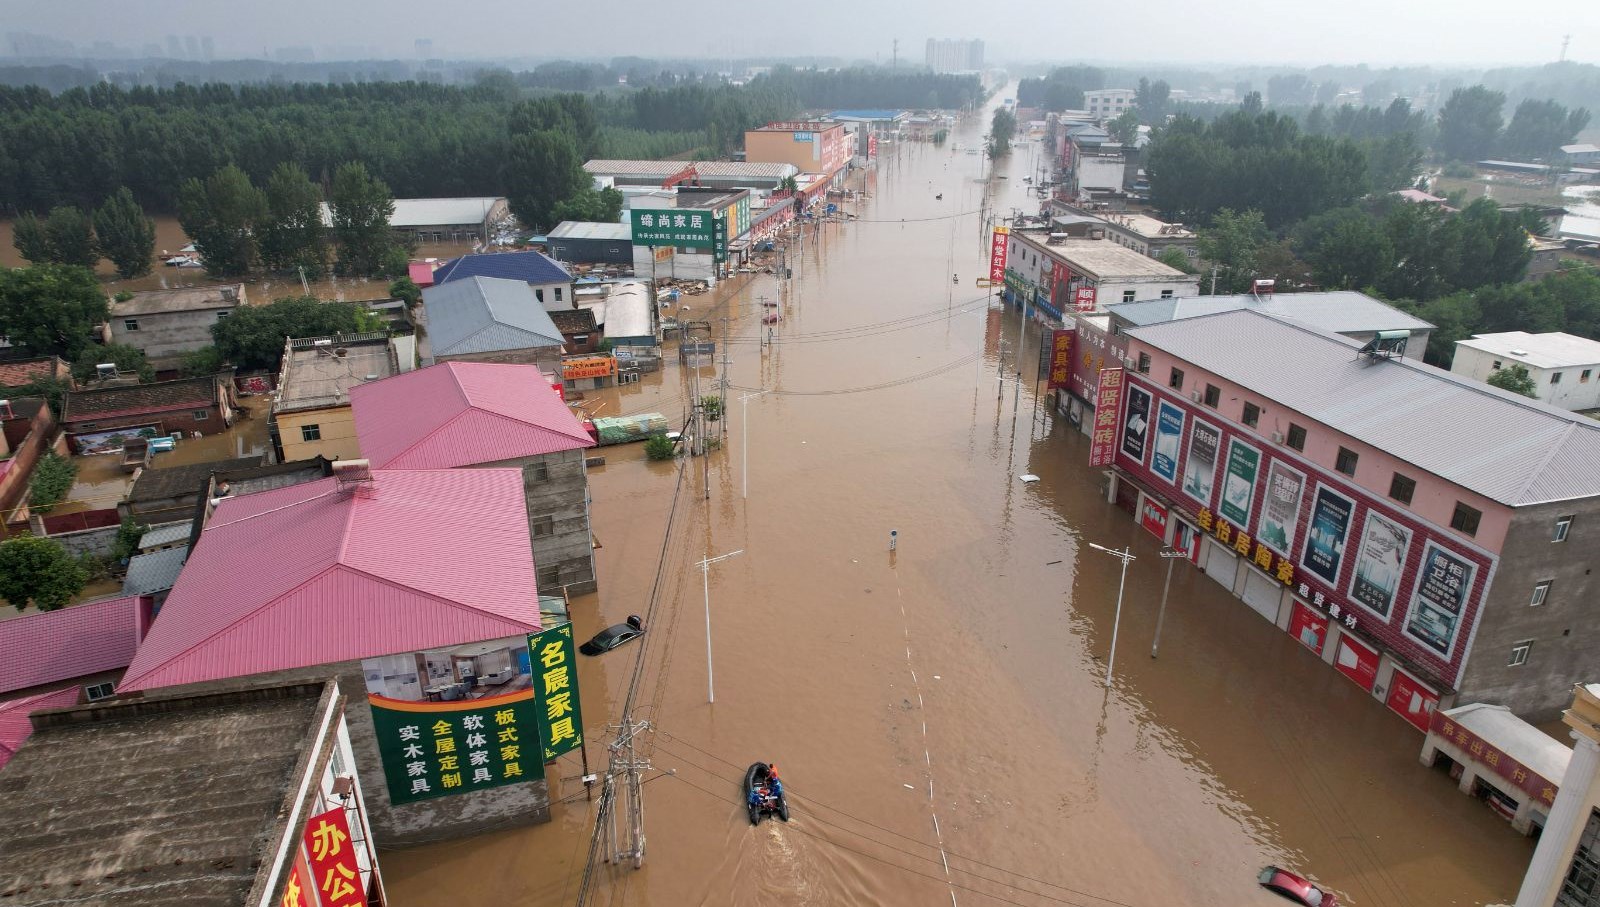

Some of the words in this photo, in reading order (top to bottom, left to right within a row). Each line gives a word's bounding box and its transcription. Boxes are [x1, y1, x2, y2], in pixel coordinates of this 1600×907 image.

[640, 213, 703, 229] 缔尚家居
[993, 234, 1006, 278] 明堂红木
[1052, 335, 1071, 382] 家具城
[1095, 370, 1121, 444] 超贤瓷砖
[1198, 506, 1295, 585] 佳怡居陶瓷
[1430, 566, 1460, 588] 卫浴
[1434, 554, 1463, 577] 橱柜
[1298, 582, 1358, 630] 超贤建材
[540, 639, 575, 747] 名宸家具
[398, 724, 431, 795] 实木家具
[432, 719, 463, 789] 全屋定制
[462, 714, 493, 784] 软体家具
[495, 708, 523, 779] 板式家具
[1442, 722, 1500, 769] 吊车出租
[312, 820, 363, 907] 办公
